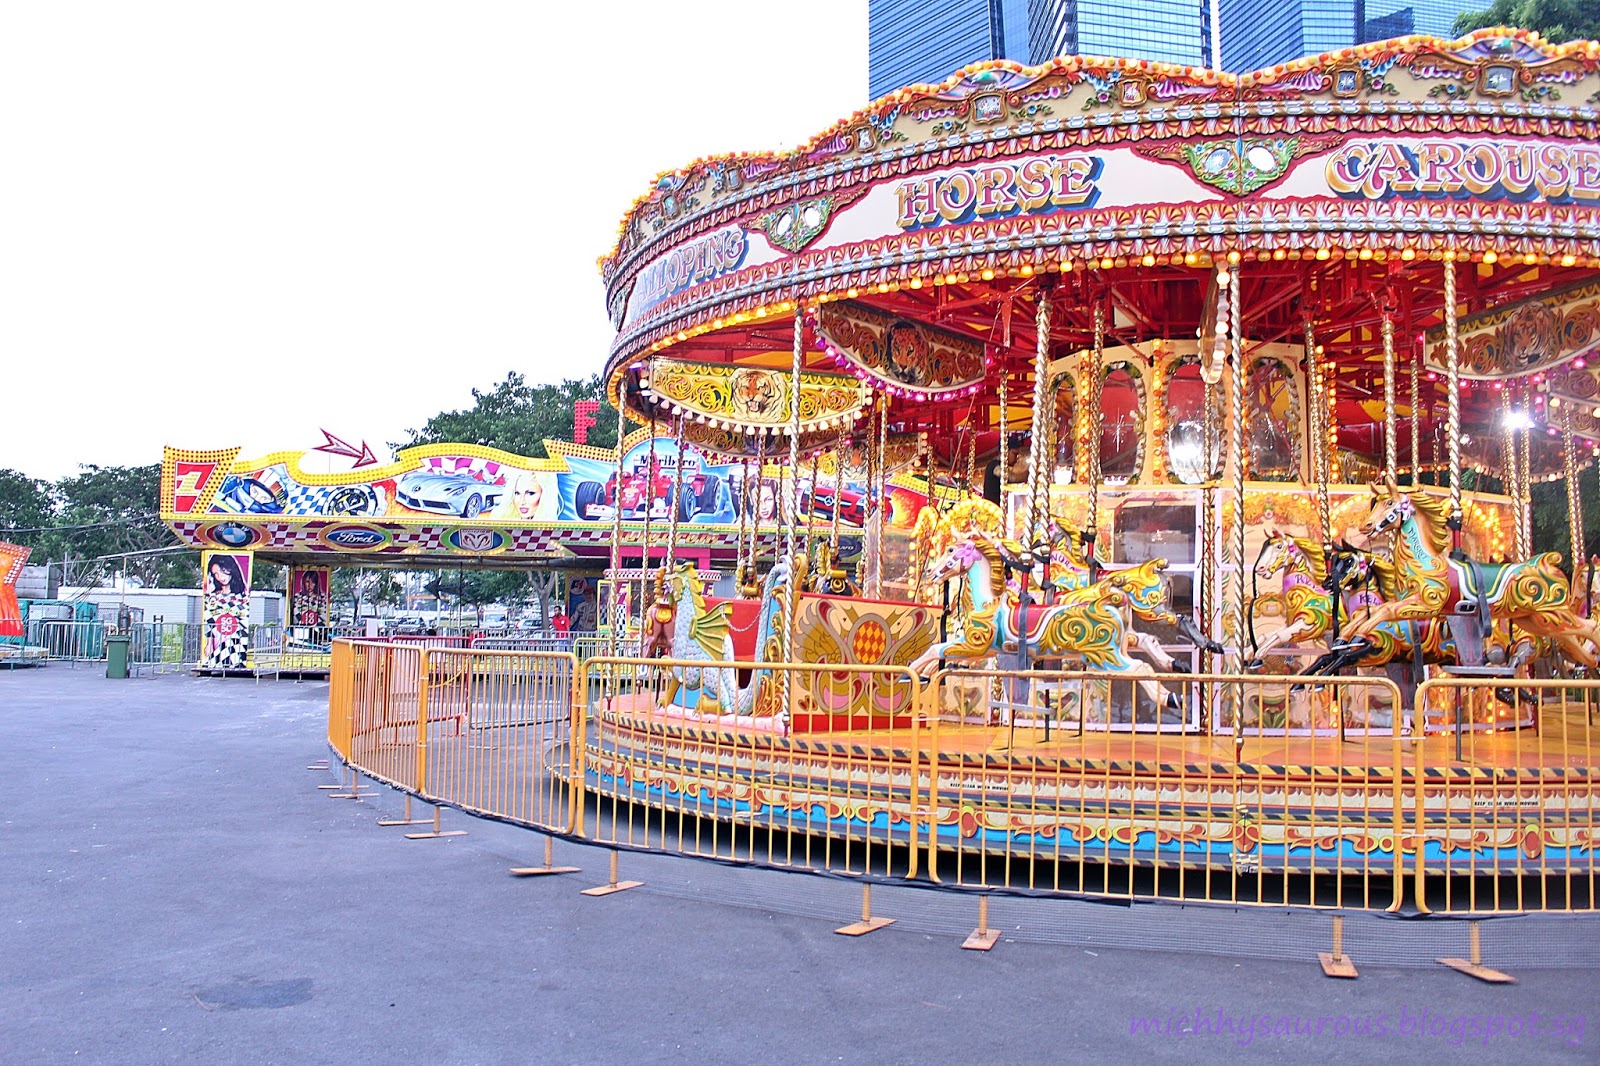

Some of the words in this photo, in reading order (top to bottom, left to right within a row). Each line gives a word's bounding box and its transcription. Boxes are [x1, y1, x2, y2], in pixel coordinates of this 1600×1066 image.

[896, 155, 1102, 231] HORSE
[631, 228, 748, 320] ALLOPING
[573, 400, 600, 444] F
[640, 455, 696, 468] Mrlbro
[336, 532, 374, 543] Ford
